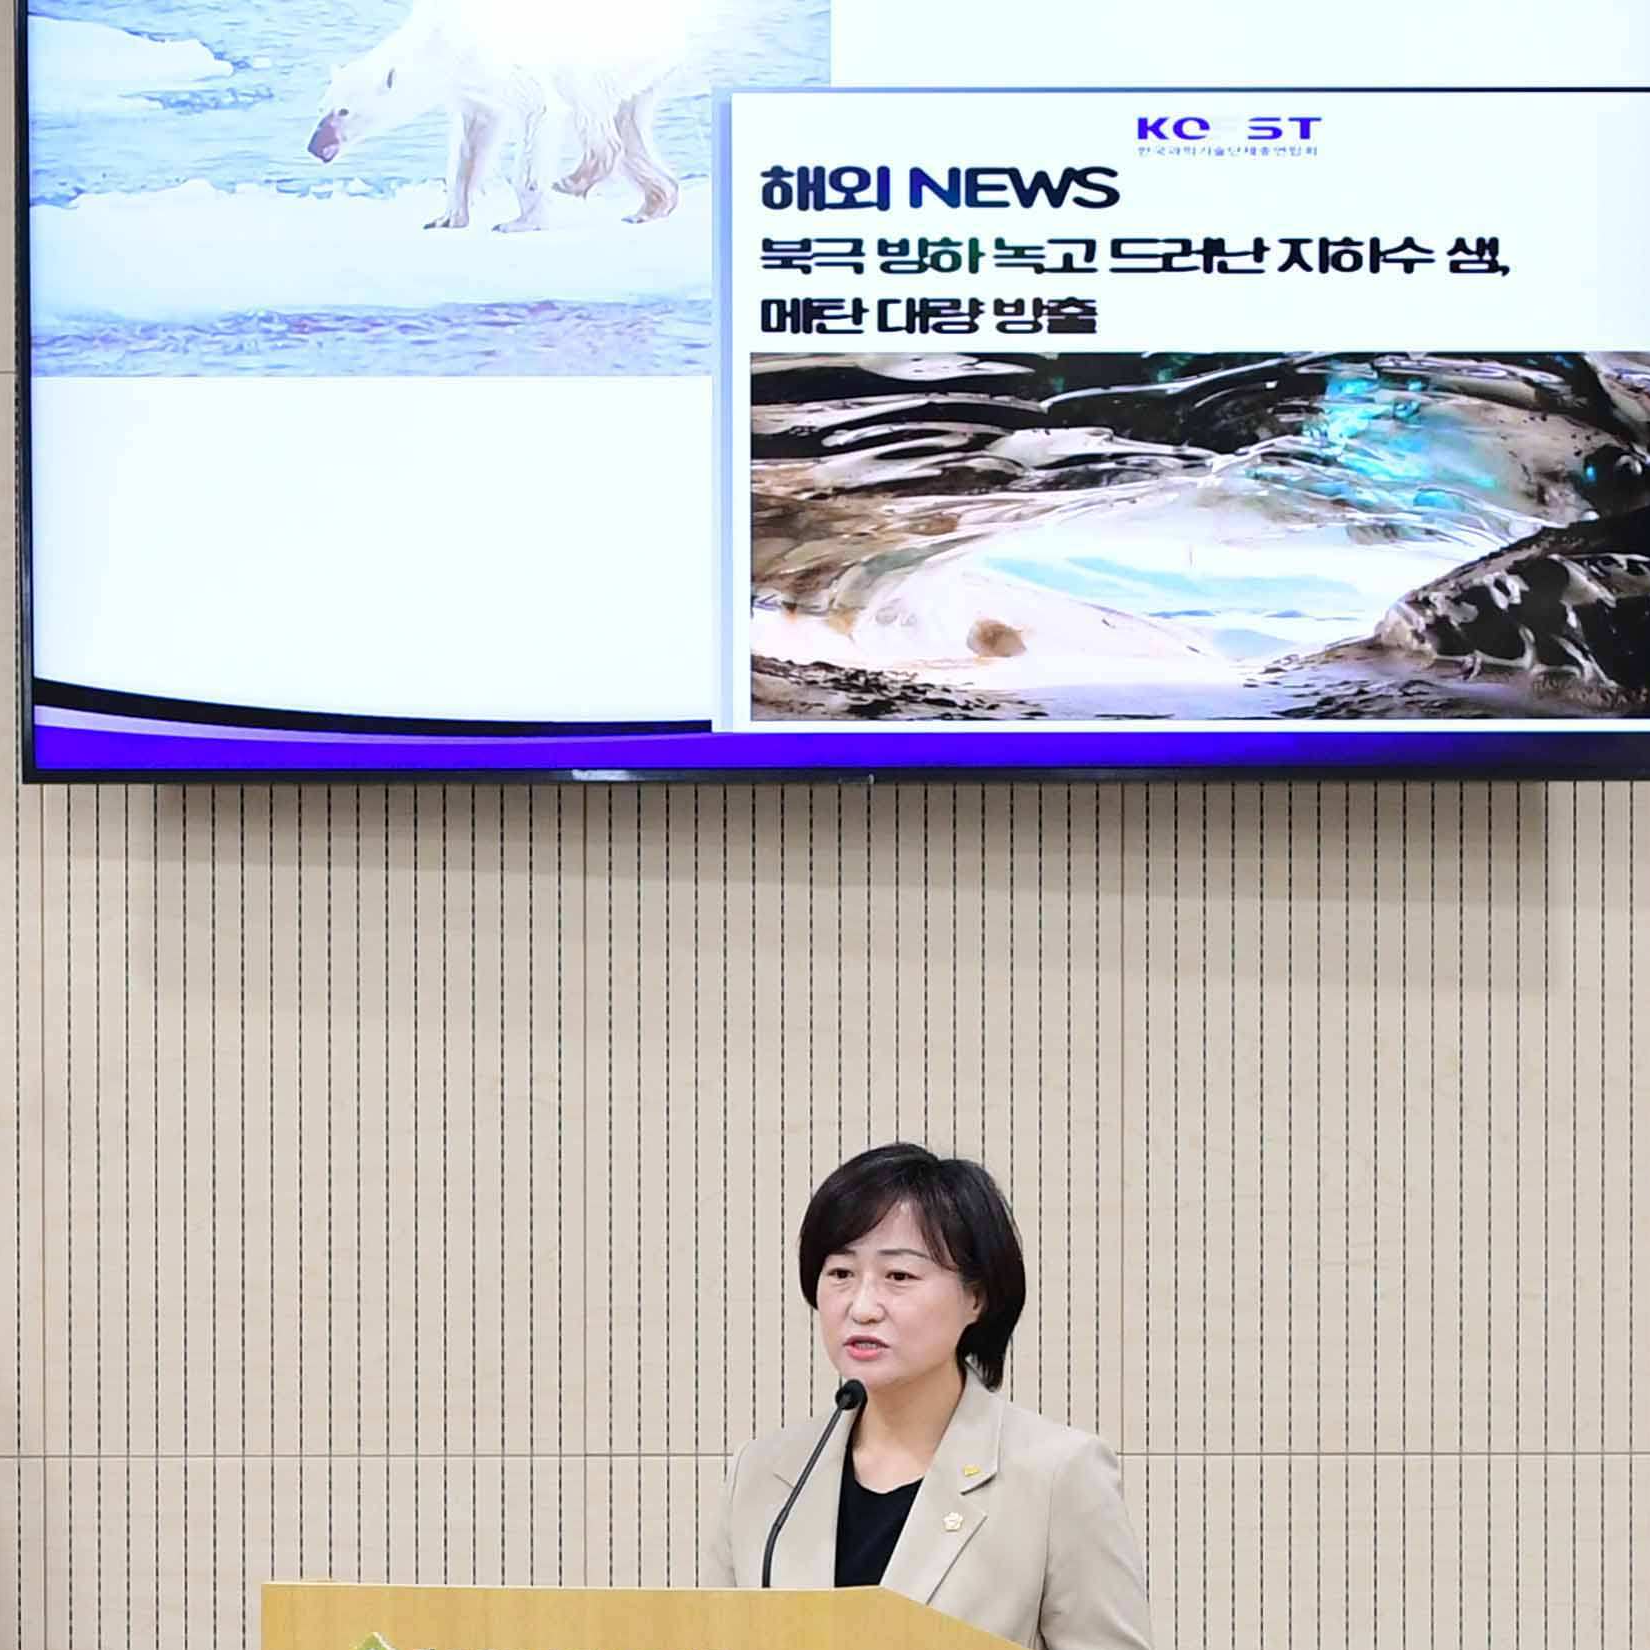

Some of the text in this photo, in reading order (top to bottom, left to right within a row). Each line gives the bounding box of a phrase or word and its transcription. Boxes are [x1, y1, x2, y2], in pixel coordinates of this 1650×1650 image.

[1137, 116, 1323, 141] KOST
[760, 165, 1121, 211] 해외 NEWS
[760, 237, 866, 275] 북극
[992, 237, 1099, 275] 녹고
[1108, 236, 1271, 275] 드러난
[1277, 236, 1436, 275] 지하수
[1446, 236, 1510, 277] 샘,
[760, 297, 1099, 335] 메탄 대량 방출
